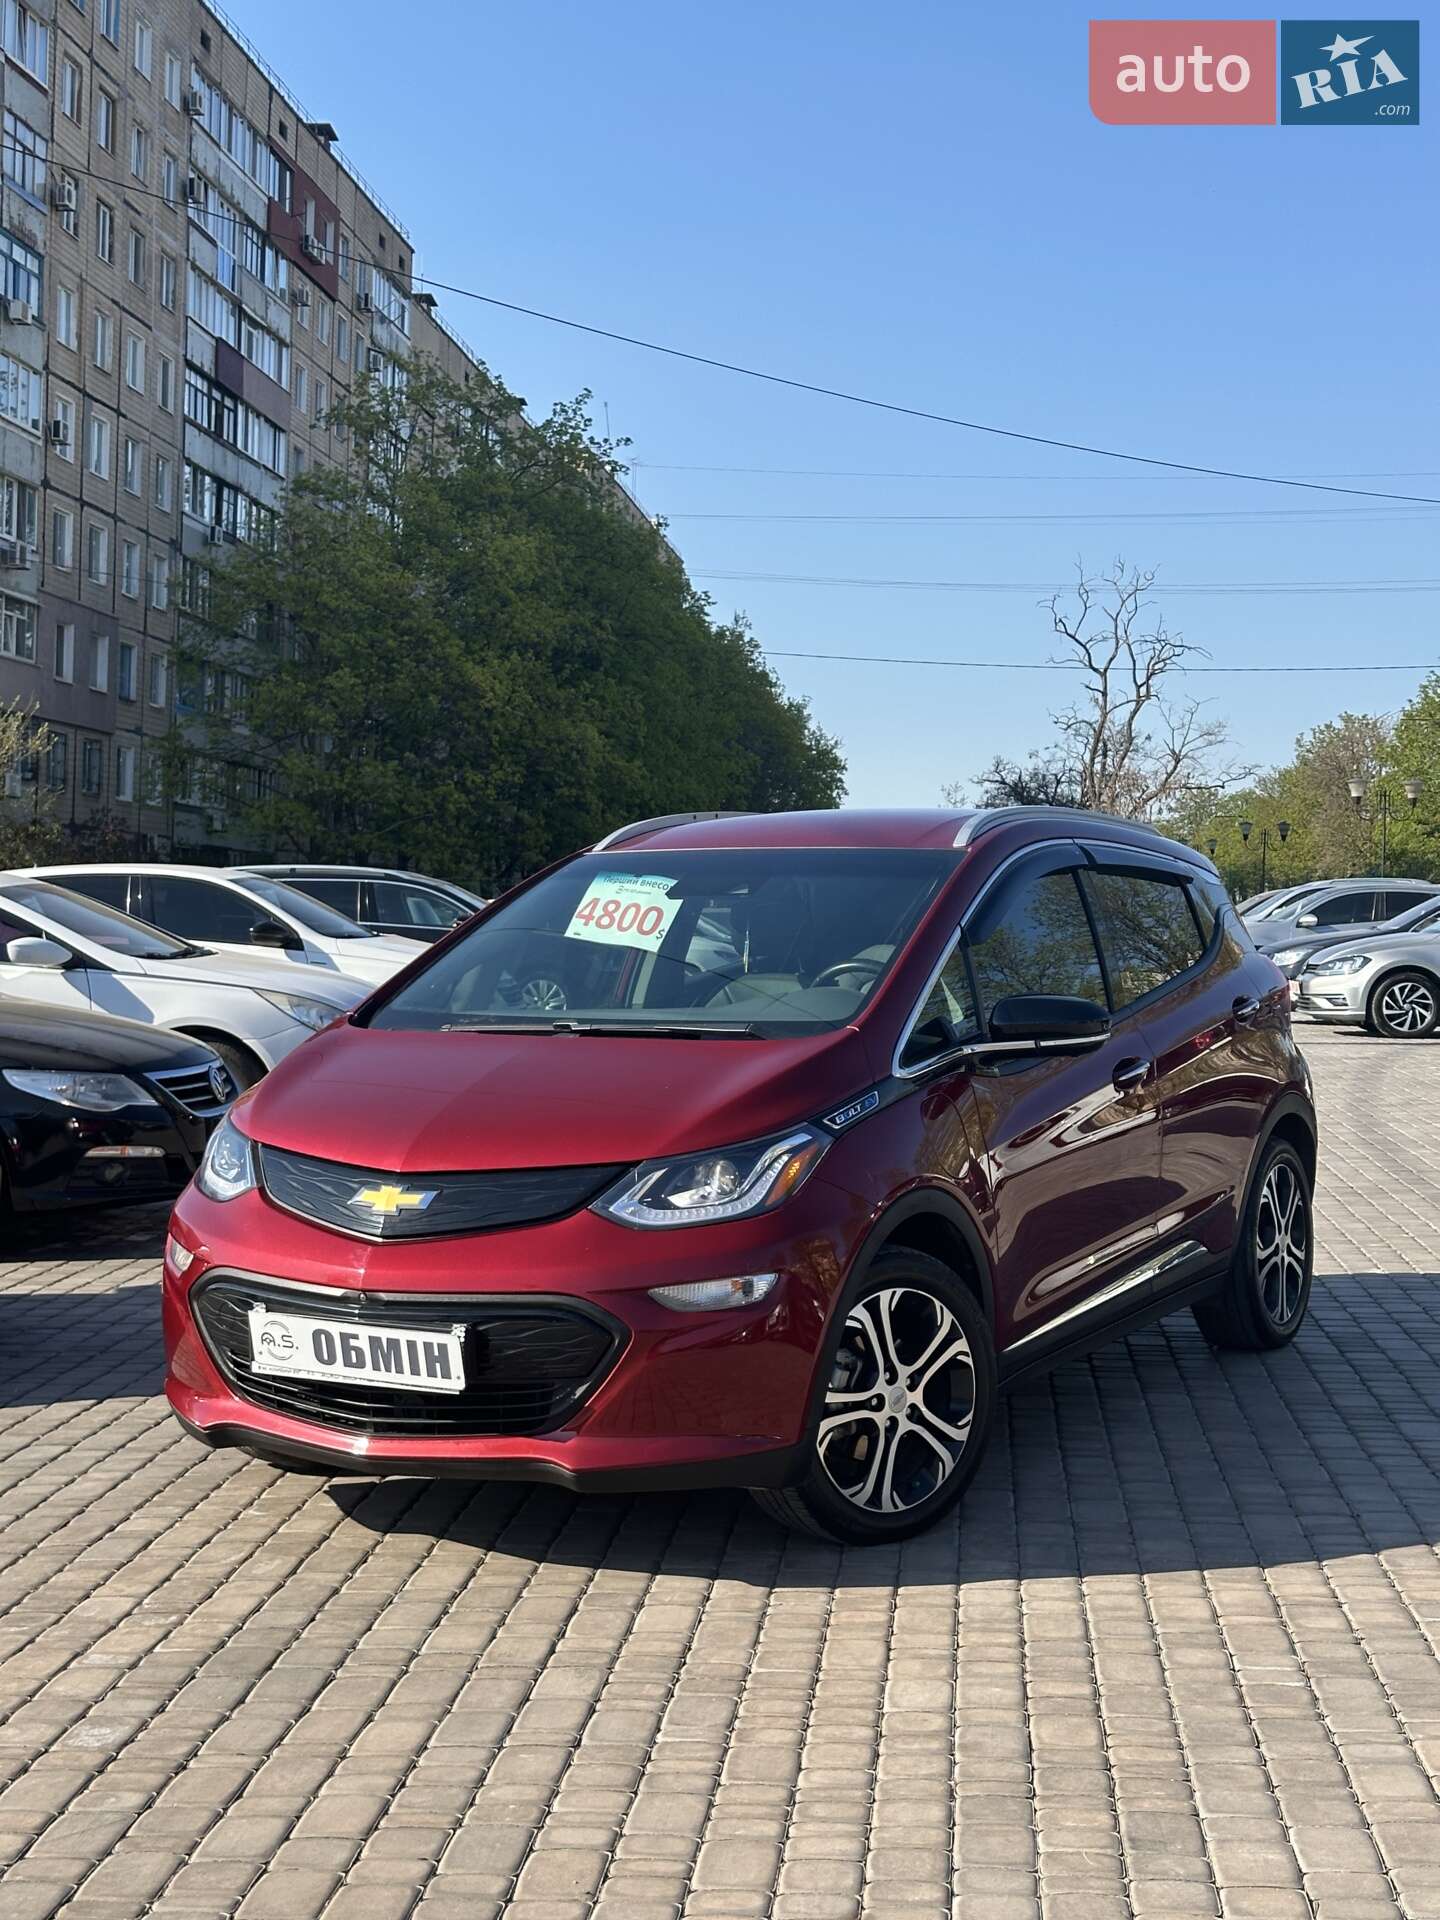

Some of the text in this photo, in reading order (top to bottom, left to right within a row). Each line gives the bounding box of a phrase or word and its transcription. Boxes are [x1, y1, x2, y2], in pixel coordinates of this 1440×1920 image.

[640, 879, 672, 891] внесо
[835, 1103, 861, 1124] BOLT
[311, 1328, 452, 1380] ОБМІН
